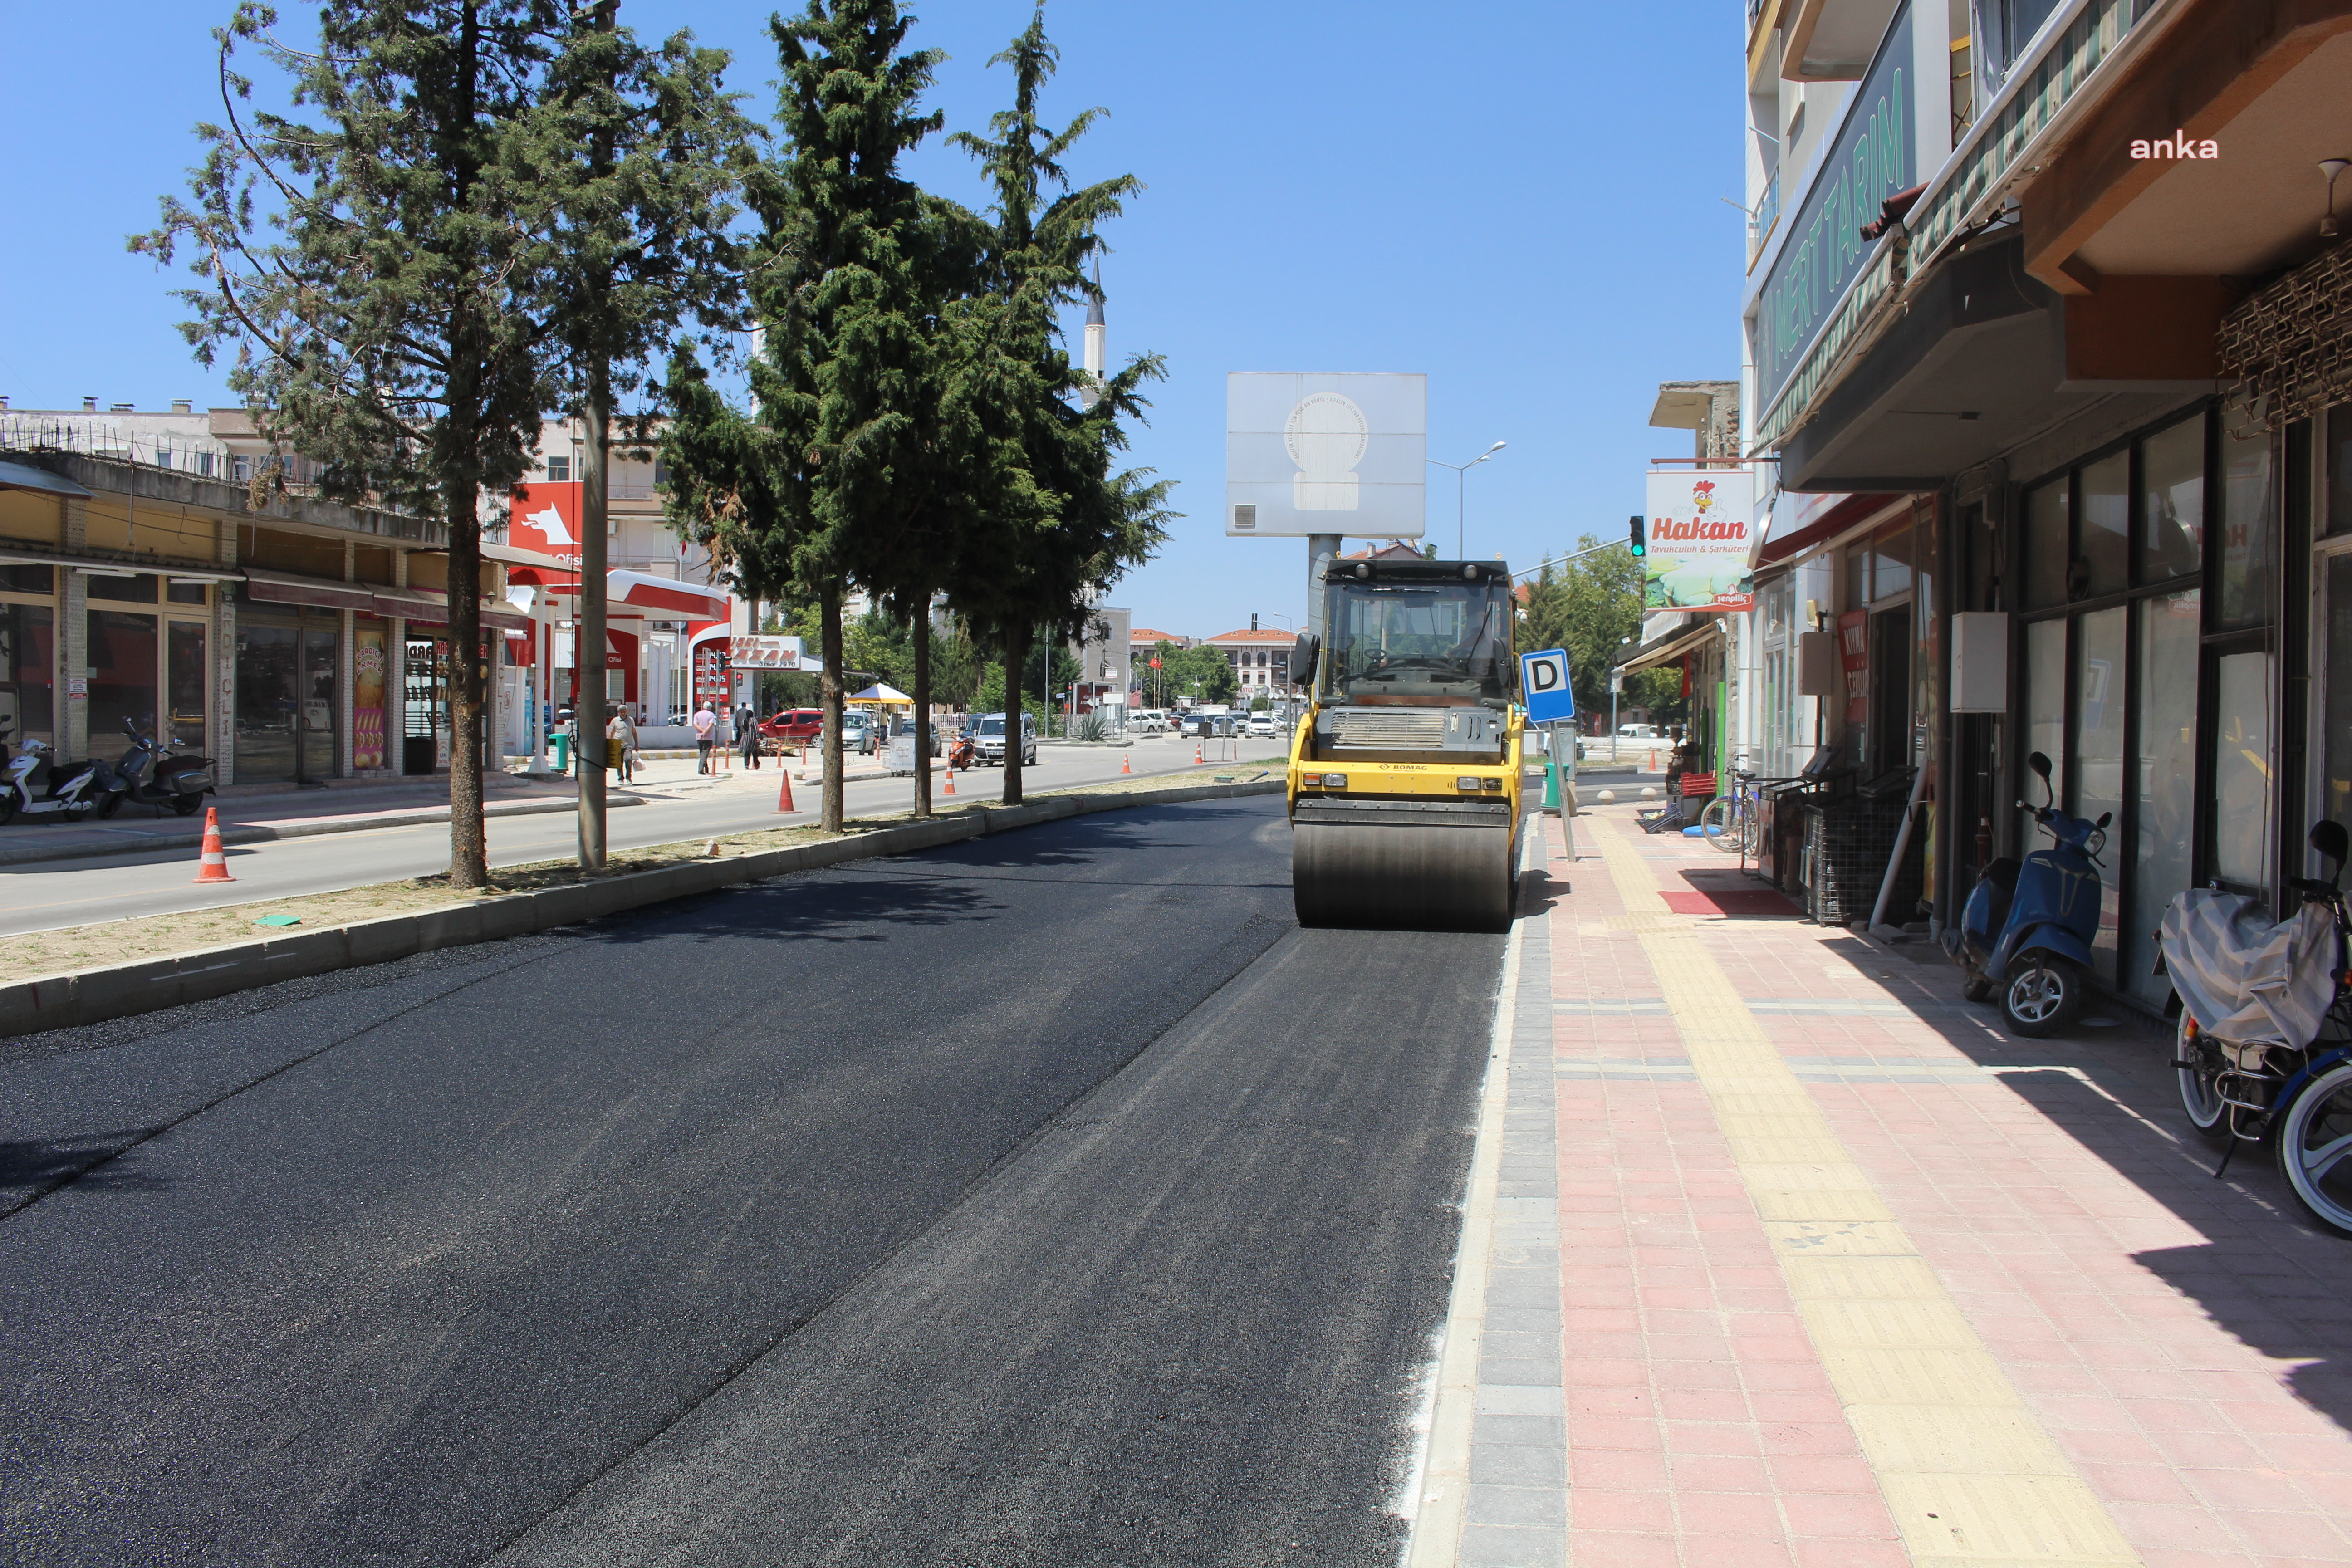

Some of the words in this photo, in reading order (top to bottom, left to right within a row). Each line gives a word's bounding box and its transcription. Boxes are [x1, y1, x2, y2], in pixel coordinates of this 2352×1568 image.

[1776, 209, 1823, 371] MERT
[1824, 67, 1904, 294] TARIM
[1333, 397, 1346, 406] GREEN
[1345, 403, 1354, 412] LIFE
[1352, 409, 1360, 418] FOR
[1357, 417, 1366, 432] FUTURE
[1651, 516, 1748, 541] Hakan
[1717, 594, 1747, 603] şenpiliç
[1844, 625, 1865, 656] KIYMA
[356, 647, 384, 663] KARDIÇLI
[731, 649, 797, 663] AZAN
[357, 660, 383, 676] EKMEK
[1532, 660, 1558, 691] D
